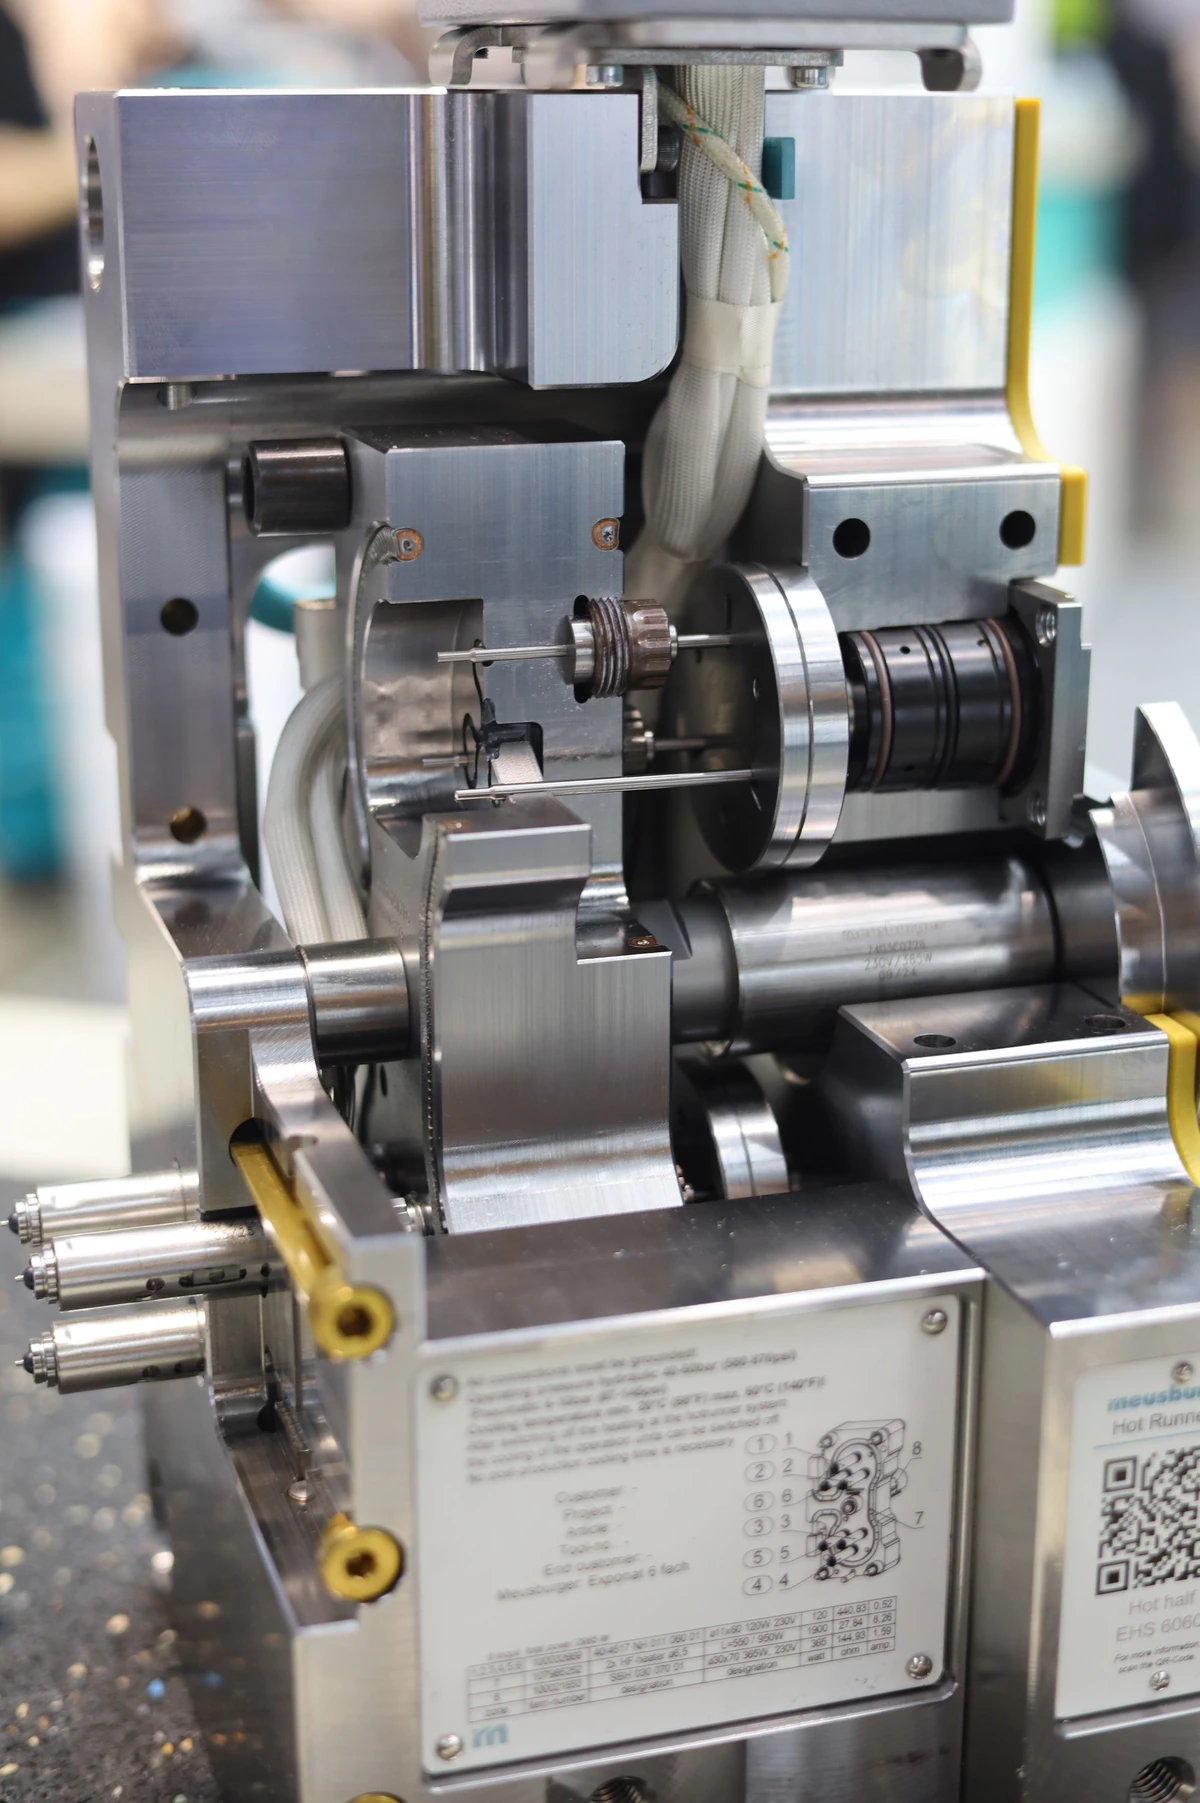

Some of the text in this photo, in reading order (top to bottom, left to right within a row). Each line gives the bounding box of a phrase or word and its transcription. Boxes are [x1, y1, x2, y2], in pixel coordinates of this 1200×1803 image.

[1112, 1417, 1145, 1437] Hot
[757, 1431, 793, 1451] 1 1
[912, 1440, 922, 1456] 8
[754, 1457, 793, 1479] 2 2
[754, 1488, 793, 1508] 6 6
[753, 1513, 791, 1534] 3 3
[915, 1510, 925, 1525] 7
[752, 1545, 791, 1565] 5 5
[543, 1562, 572, 1577] End
[588, 1569, 644, 1586] Exponat
[648, 1564, 657, 1577] 6
[661, 1560, 690, 1575] fach
[752, 1573, 789, 1592] 4 4
[1128, 1591, 1197, 1617] Hot half
[669, 1632, 687, 1645] 060
[690, 1630, 701, 1641] 01
[745, 1617, 771, 1632] 120W
[774, 1613, 797, 1627] 230V
[812, 1609, 829, 1621] 120
[720, 1637, 750, 1651] L=550
[757, 1628, 785, 1643] 950W
[807, 1622, 829, 1636] 1900
[1116, 1621, 1156, 1643] EHS
[634, 1667, 652, 1680] 030
[654, 1664, 671, 1676] 070
[673, 1660, 685, 1672] 01
[774, 1640, 798, 1655] 230V
[811, 1635, 828, 1648] 365
[1113, 1652, 1130, 1664] For
[1130, 1649, 1153, 1660] more
[620, 1678, 673, 1696] designation
[726, 1659, 779, 1679] designation
[807, 1651, 827, 1664] watt
[841, 1645, 862, 1658] ohm
[1118, 1663, 1139, 1675] scan
[1140, 1660, 1153, 1670] the
